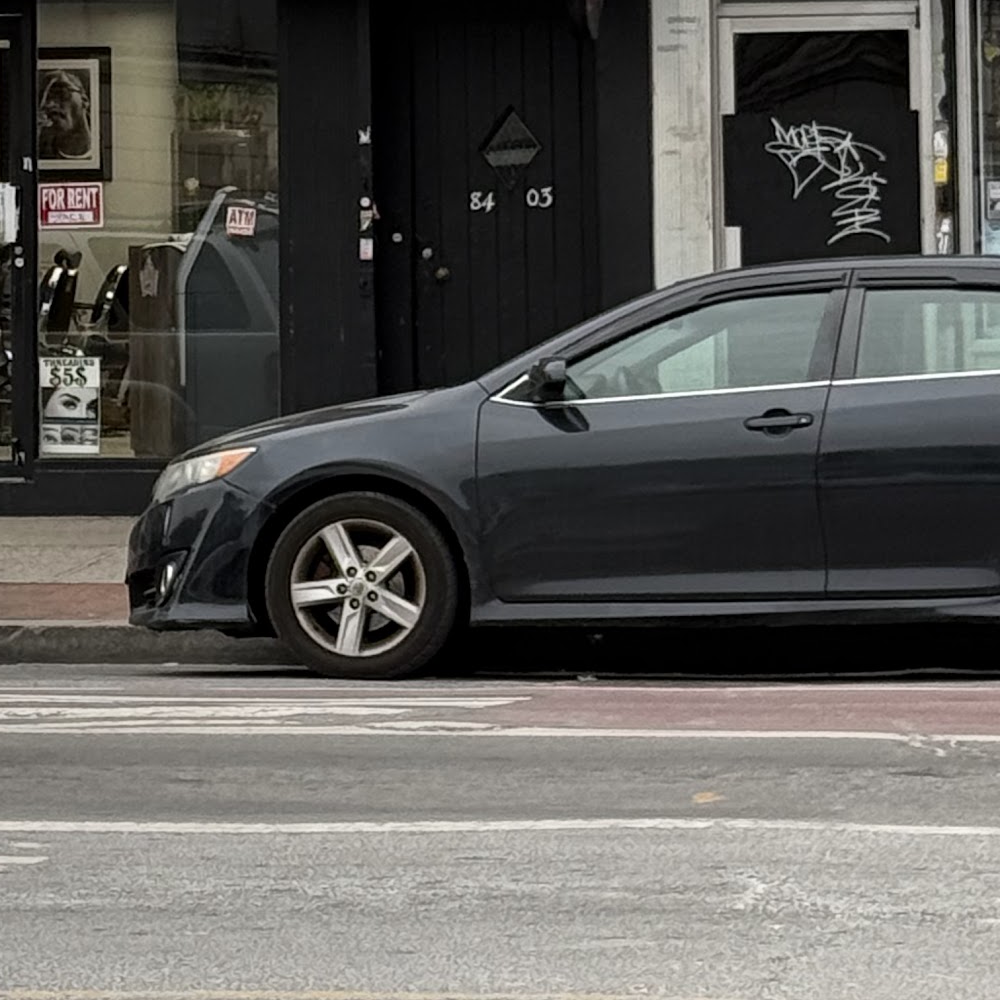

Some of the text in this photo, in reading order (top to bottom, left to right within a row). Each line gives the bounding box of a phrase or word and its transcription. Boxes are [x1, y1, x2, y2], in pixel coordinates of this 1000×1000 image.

[42, 186, 99, 210] FOR RENT
[470, 187, 553, 213] 84 03
[229, 209, 255, 226] ATM
